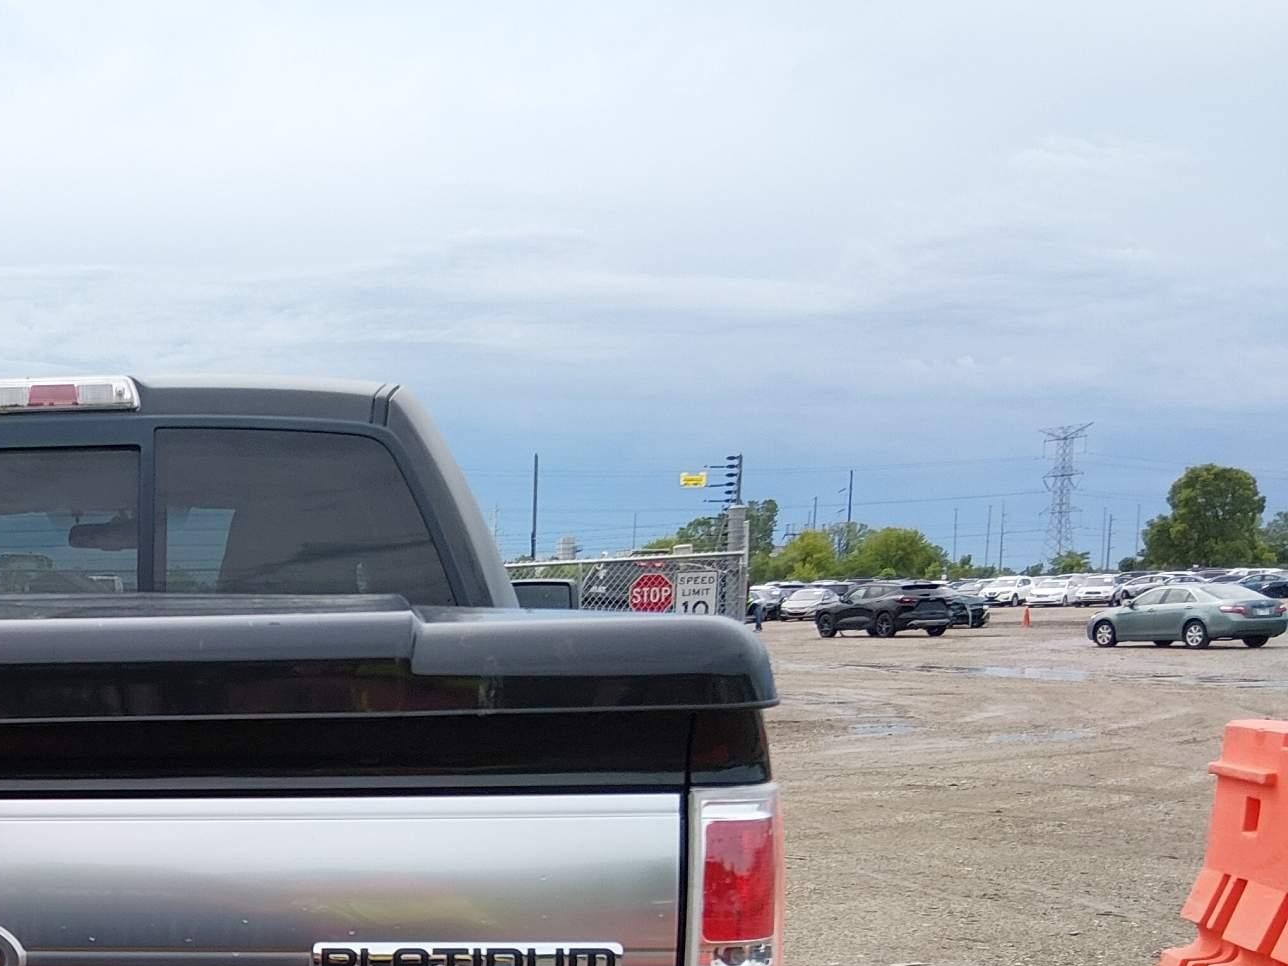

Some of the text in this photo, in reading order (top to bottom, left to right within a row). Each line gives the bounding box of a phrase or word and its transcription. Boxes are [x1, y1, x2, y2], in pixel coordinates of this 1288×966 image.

[678, 576, 715, 585] SPEED
[632, 587, 671, 604] STOP
[681, 588, 711, 597] LIMIT
[681, 600, 710, 615] 10
